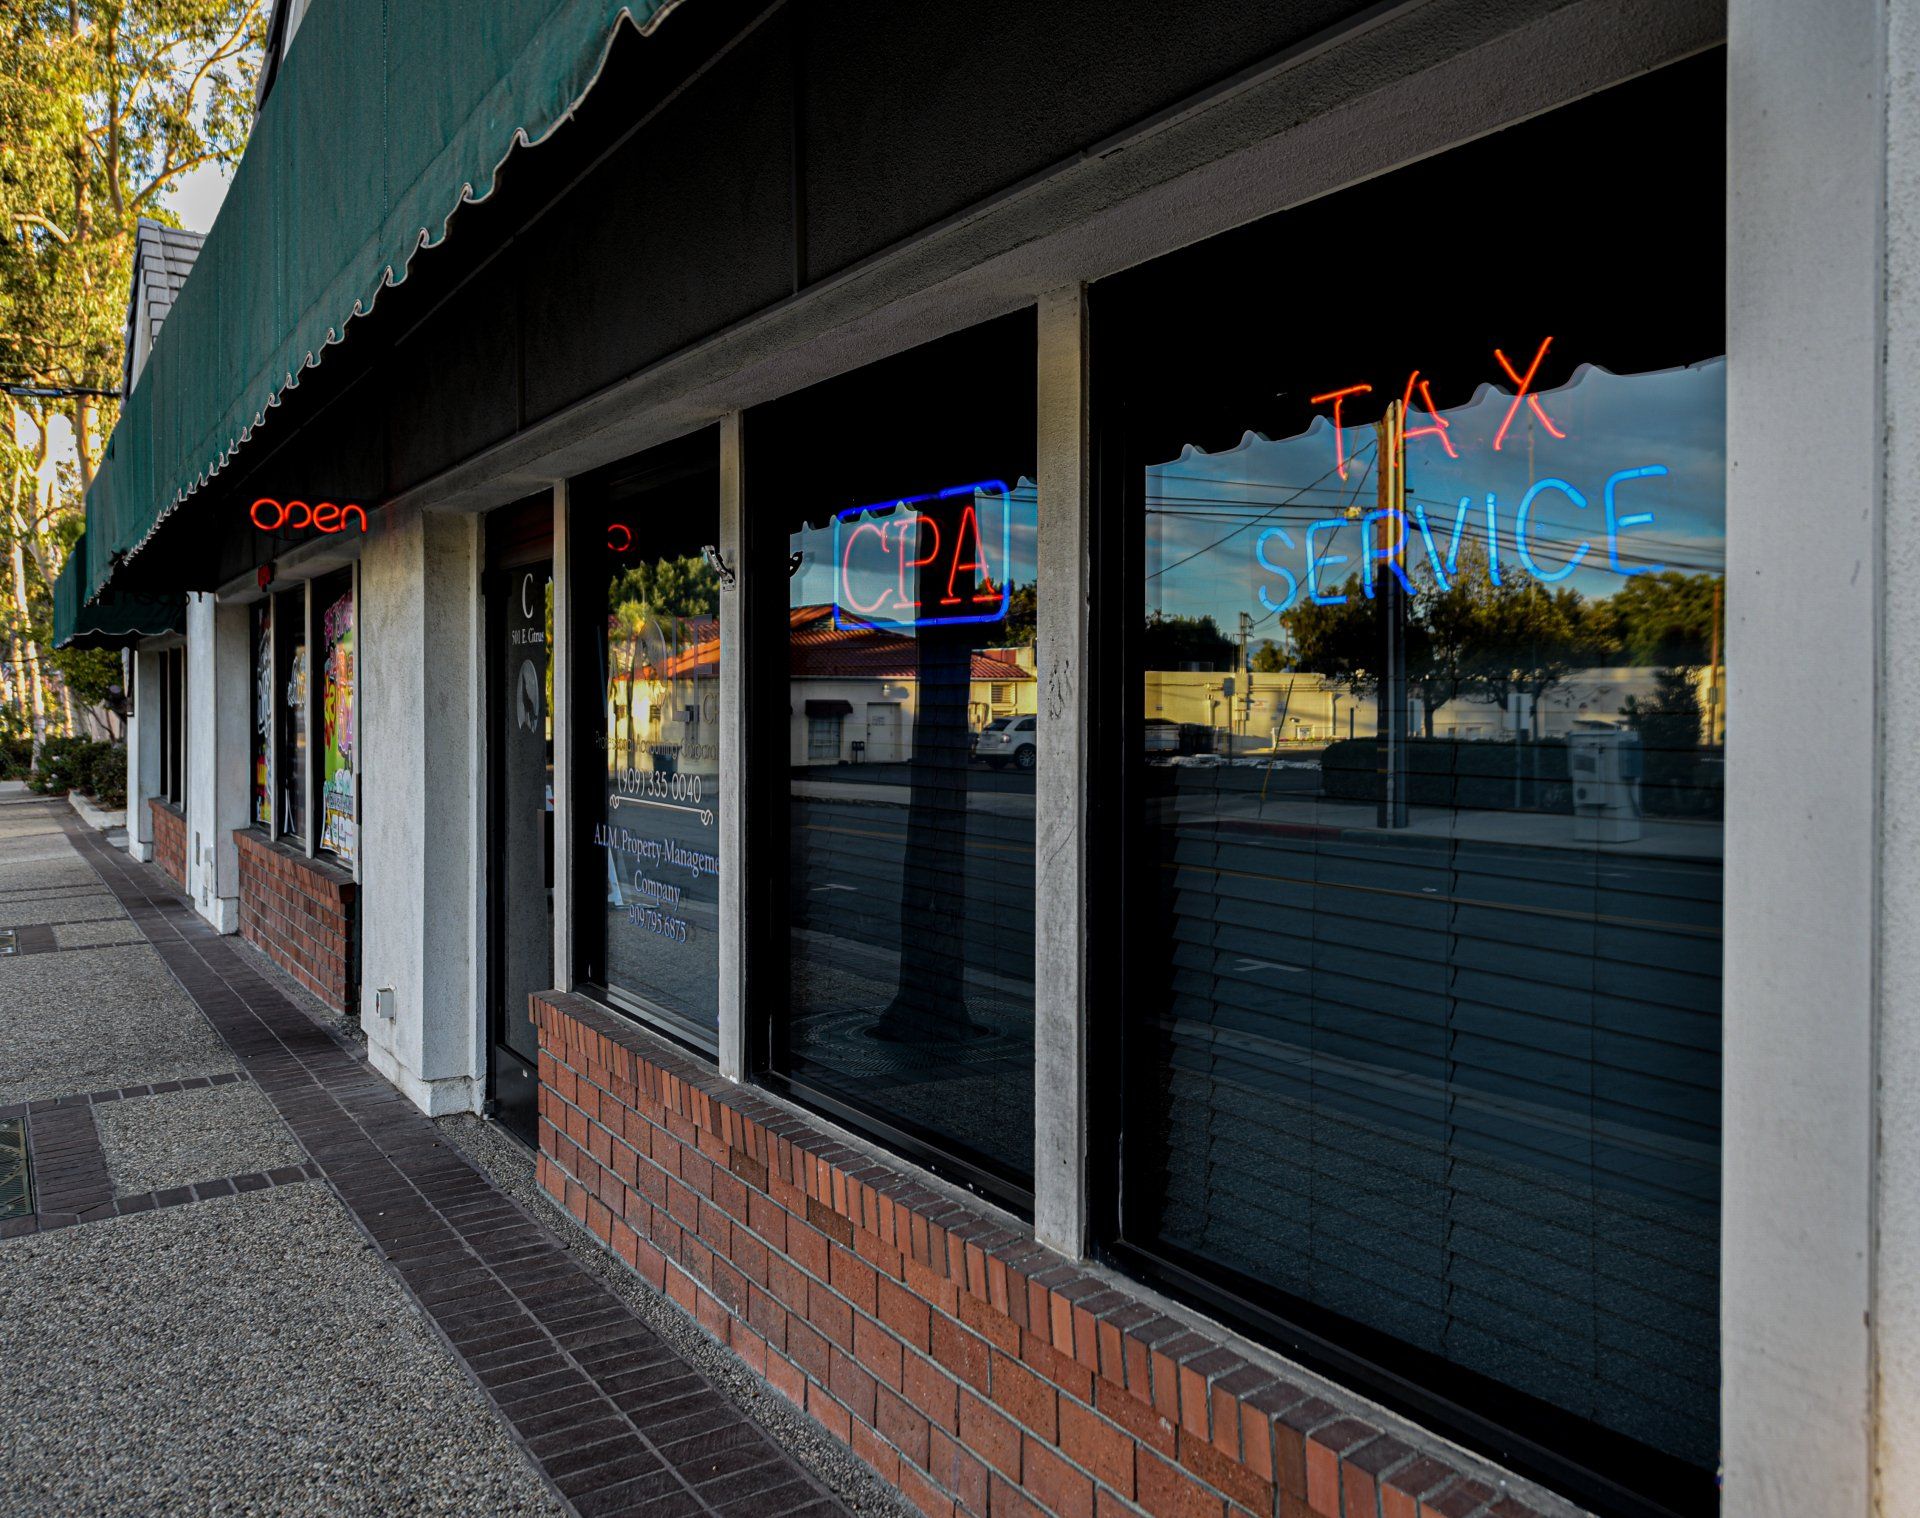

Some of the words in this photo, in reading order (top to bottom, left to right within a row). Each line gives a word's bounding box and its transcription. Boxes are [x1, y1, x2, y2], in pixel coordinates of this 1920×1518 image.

[1311, 336, 1567, 481] TAX
[842, 505, 1004, 613] CPA
[1254, 463, 1670, 613] SERVICE
[521, 573, 534, 619] C
[617, 767, 645, 797] (909)
[647, 769, 669, 799] 335
[671, 772, 702, 804] 0040
[634, 869, 681, 911] Company
[628, 904, 687, 944] 909.795.6875
